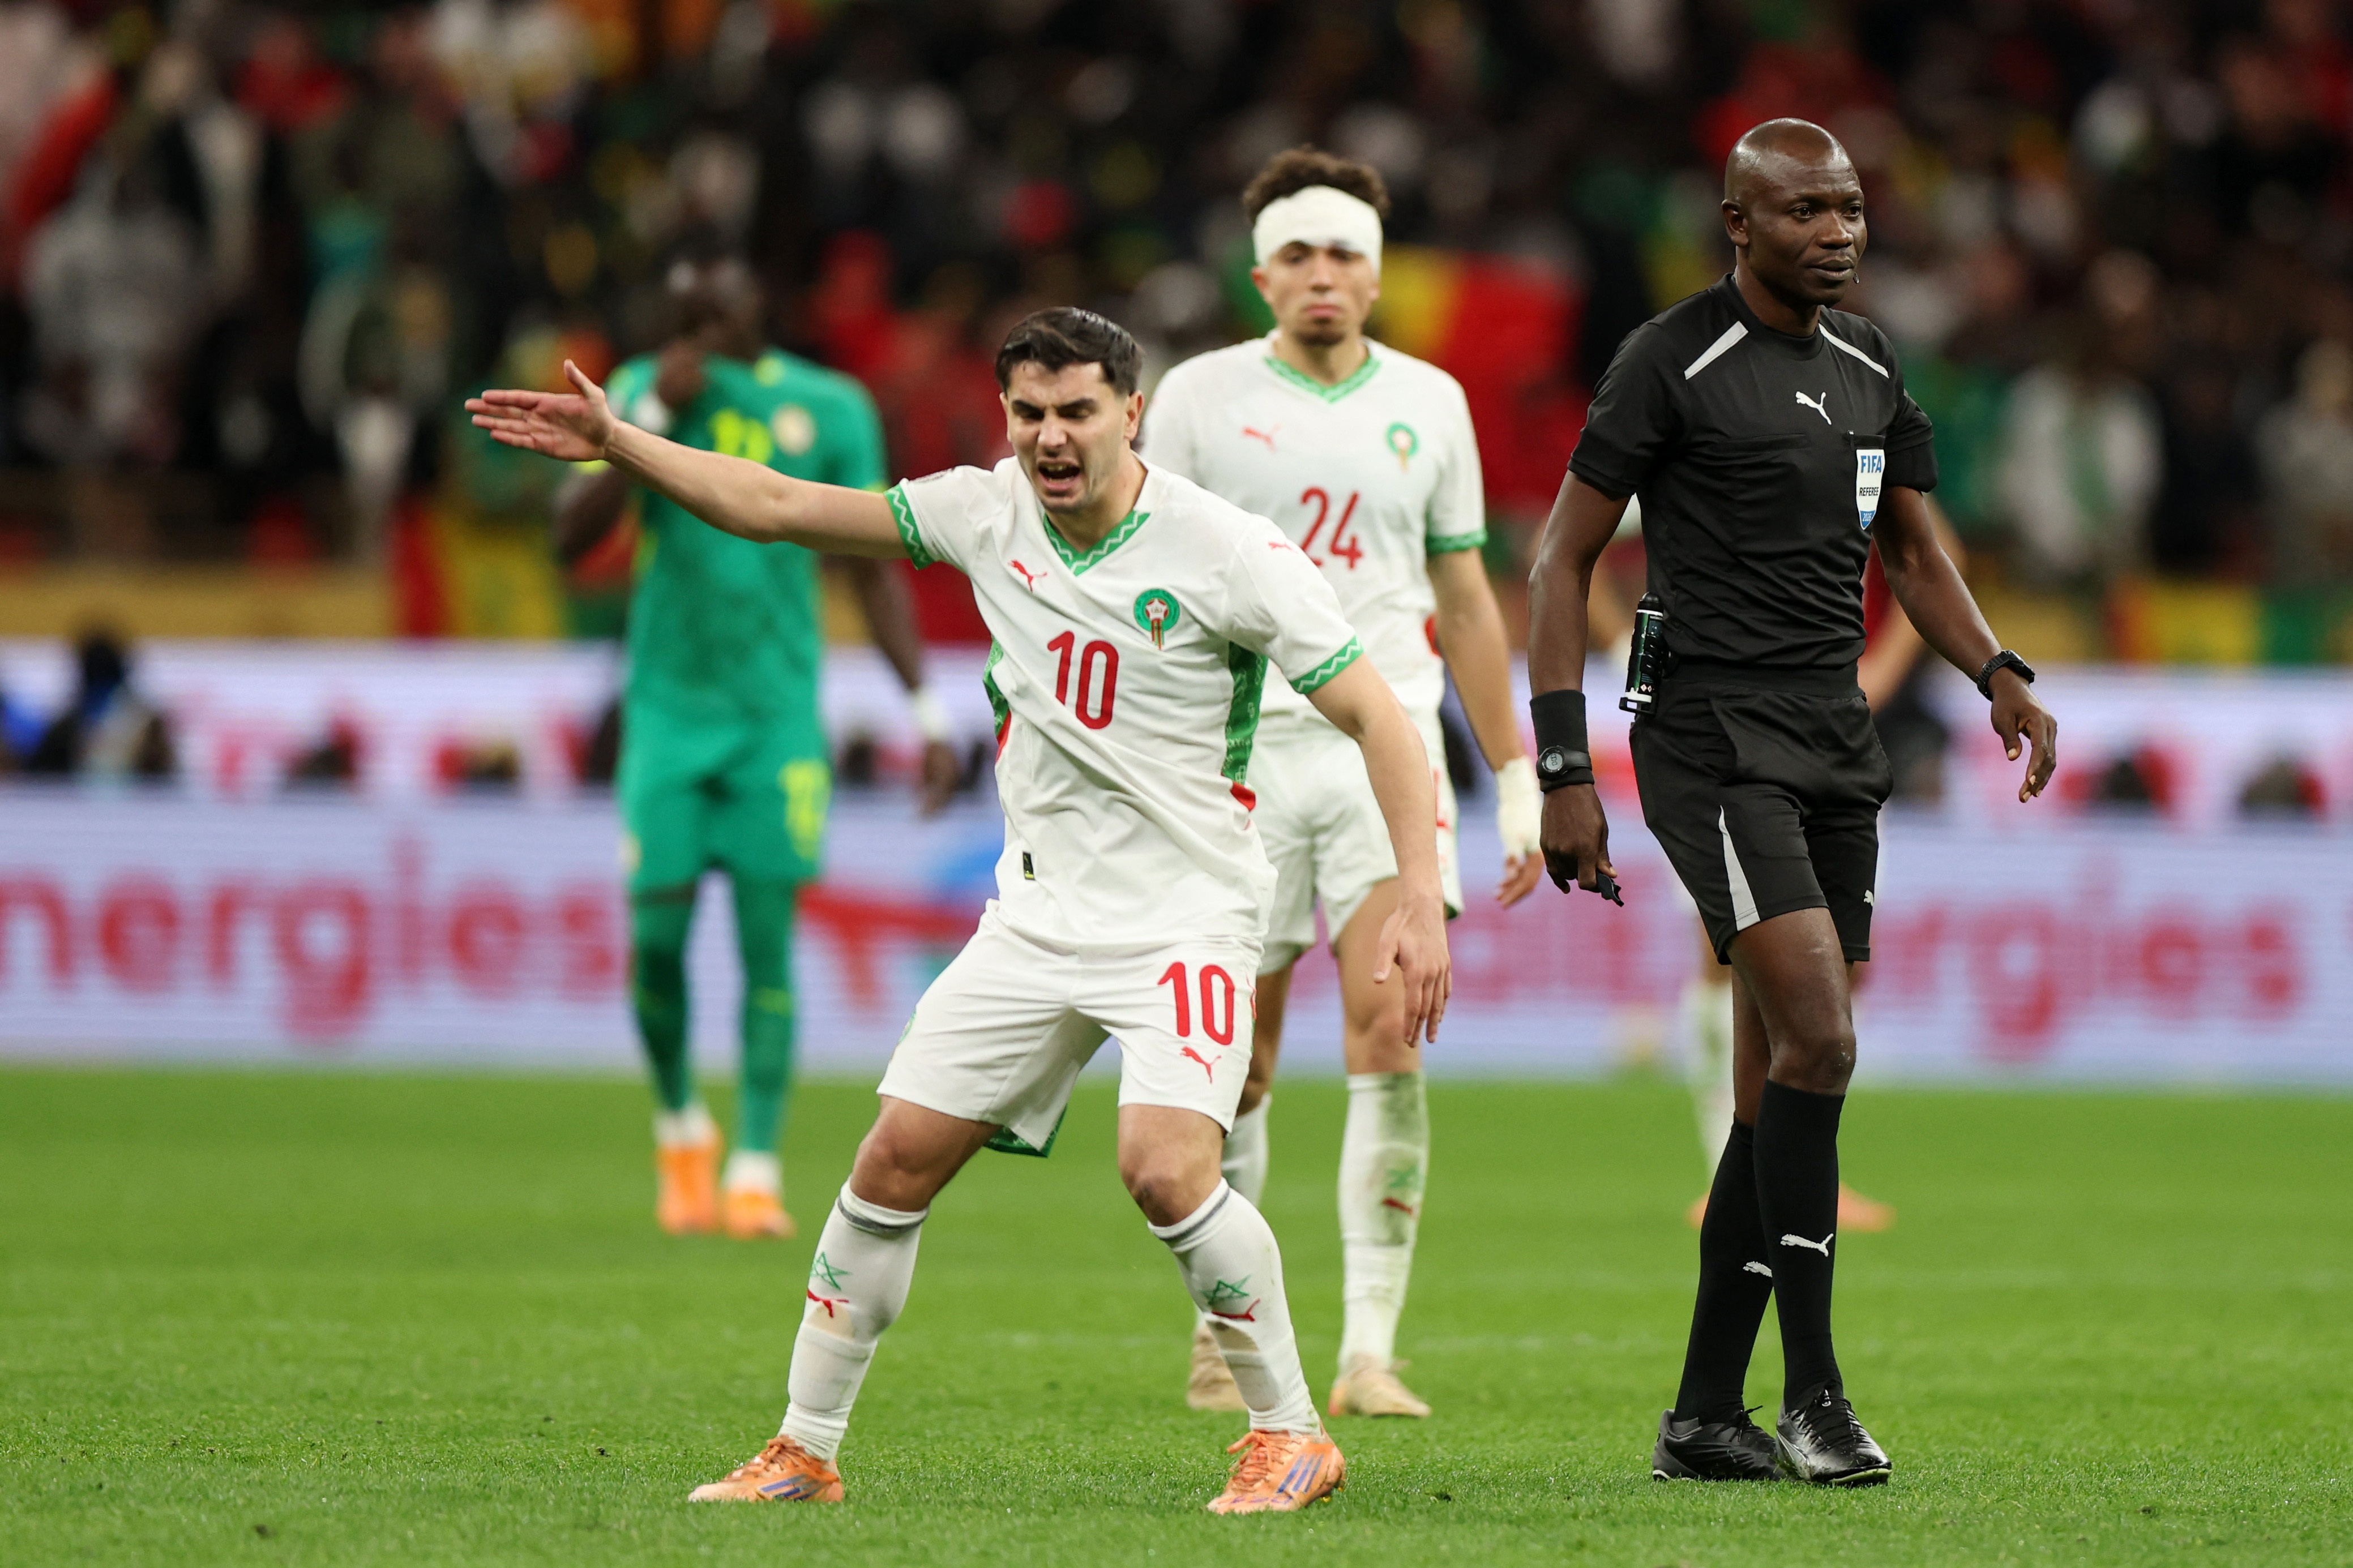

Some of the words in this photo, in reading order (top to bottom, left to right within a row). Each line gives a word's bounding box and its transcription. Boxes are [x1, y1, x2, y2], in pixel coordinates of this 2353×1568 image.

[1859, 487, 1879, 496] REFEREE
[1860, 455, 1883, 473] FIFA
[1300, 486, 1364, 569] 24
[1047, 630, 1119, 729] 10
[1157, 961, 1235, 1045] 10
